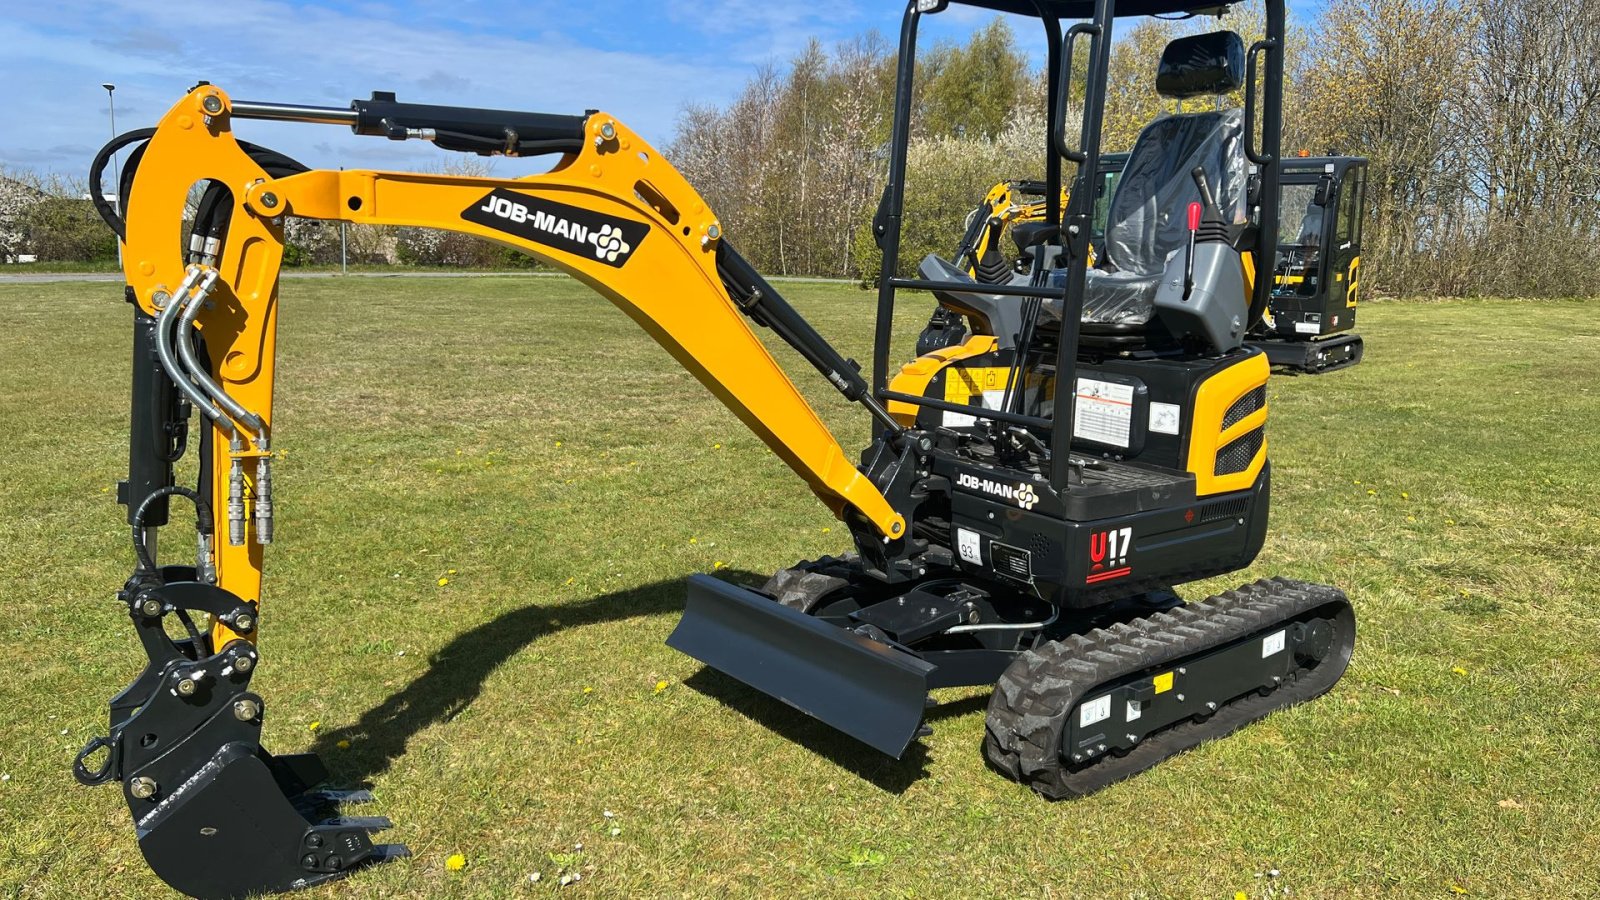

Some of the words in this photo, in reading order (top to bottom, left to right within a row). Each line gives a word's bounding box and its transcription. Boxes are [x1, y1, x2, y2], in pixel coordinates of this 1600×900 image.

[481, 195, 588, 244] JOB-MAN
[956, 473, 1012, 499] JOB-MAN
[961, 544, 973, 559] 93
[1091, 526, 1132, 563] U17
